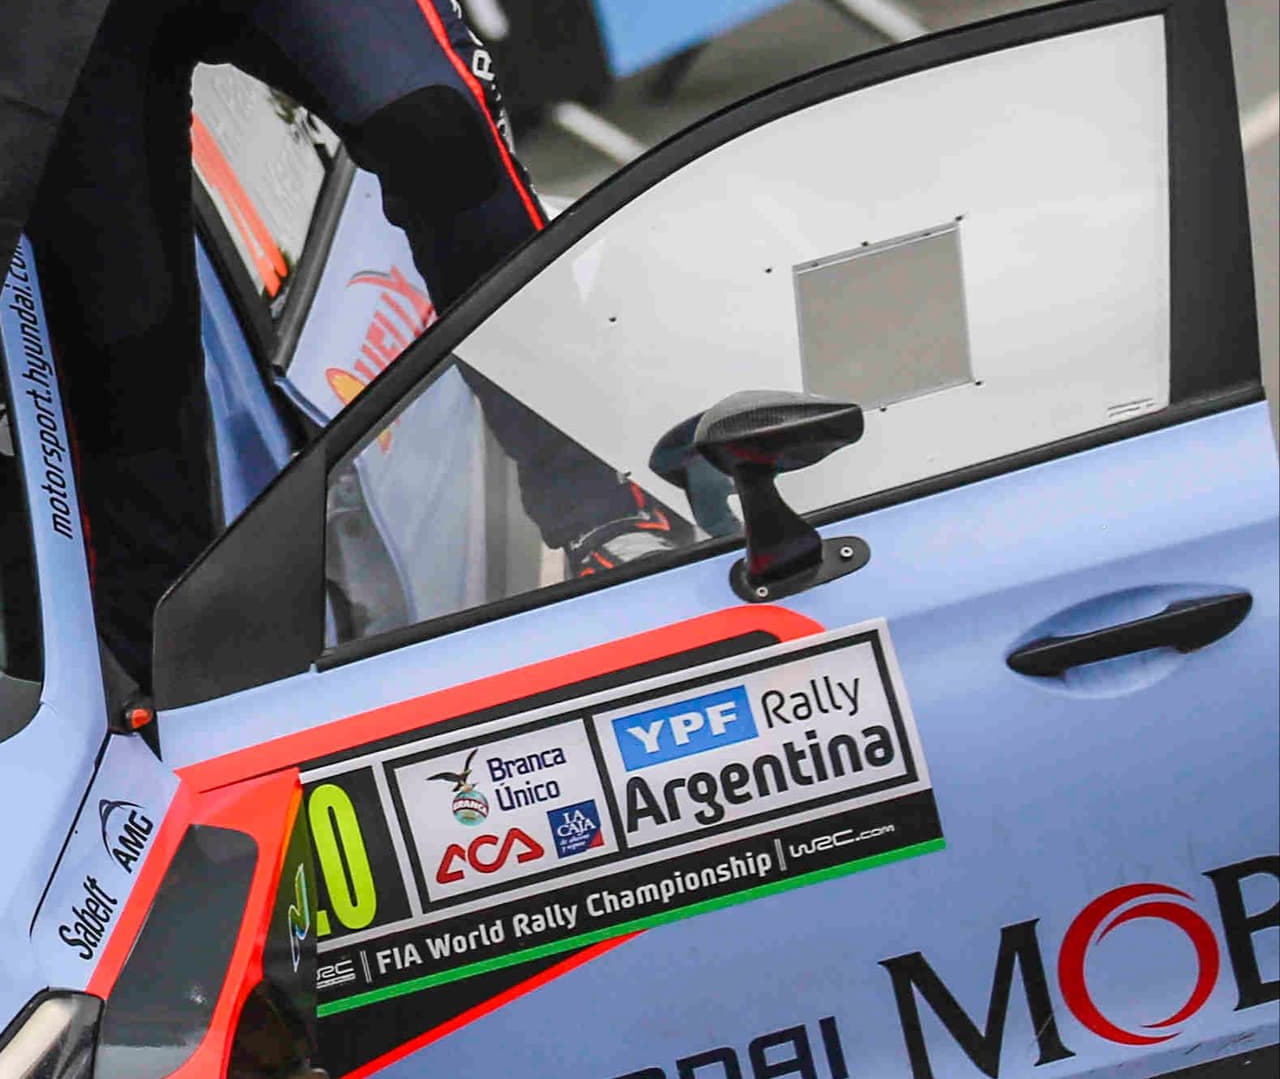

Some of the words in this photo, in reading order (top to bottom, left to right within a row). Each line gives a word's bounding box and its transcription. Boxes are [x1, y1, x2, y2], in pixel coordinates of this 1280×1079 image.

[626, 700, 739, 754] YPF
[760, 675, 860, 729] Rally
[486, 747, 568, 782] Branca
[494, 779, 561, 812] Único
[625, 724, 894, 834] Argentina
[112, 809, 154, 874] AMG
[556, 819, 597, 838] CAJA
[562, 809, 587, 823] LA
[316, 783, 377, 937] 0
[435, 827, 545, 885] ACA
[58, 874, 118, 961] Sabelt
[376, 943, 423, 975] FIA
[426, 919, 505, 959] World
[513, 901, 579, 937] Rally
[585, 847, 773, 917] Championship
[877, 853, 1280, 1079] MOB
